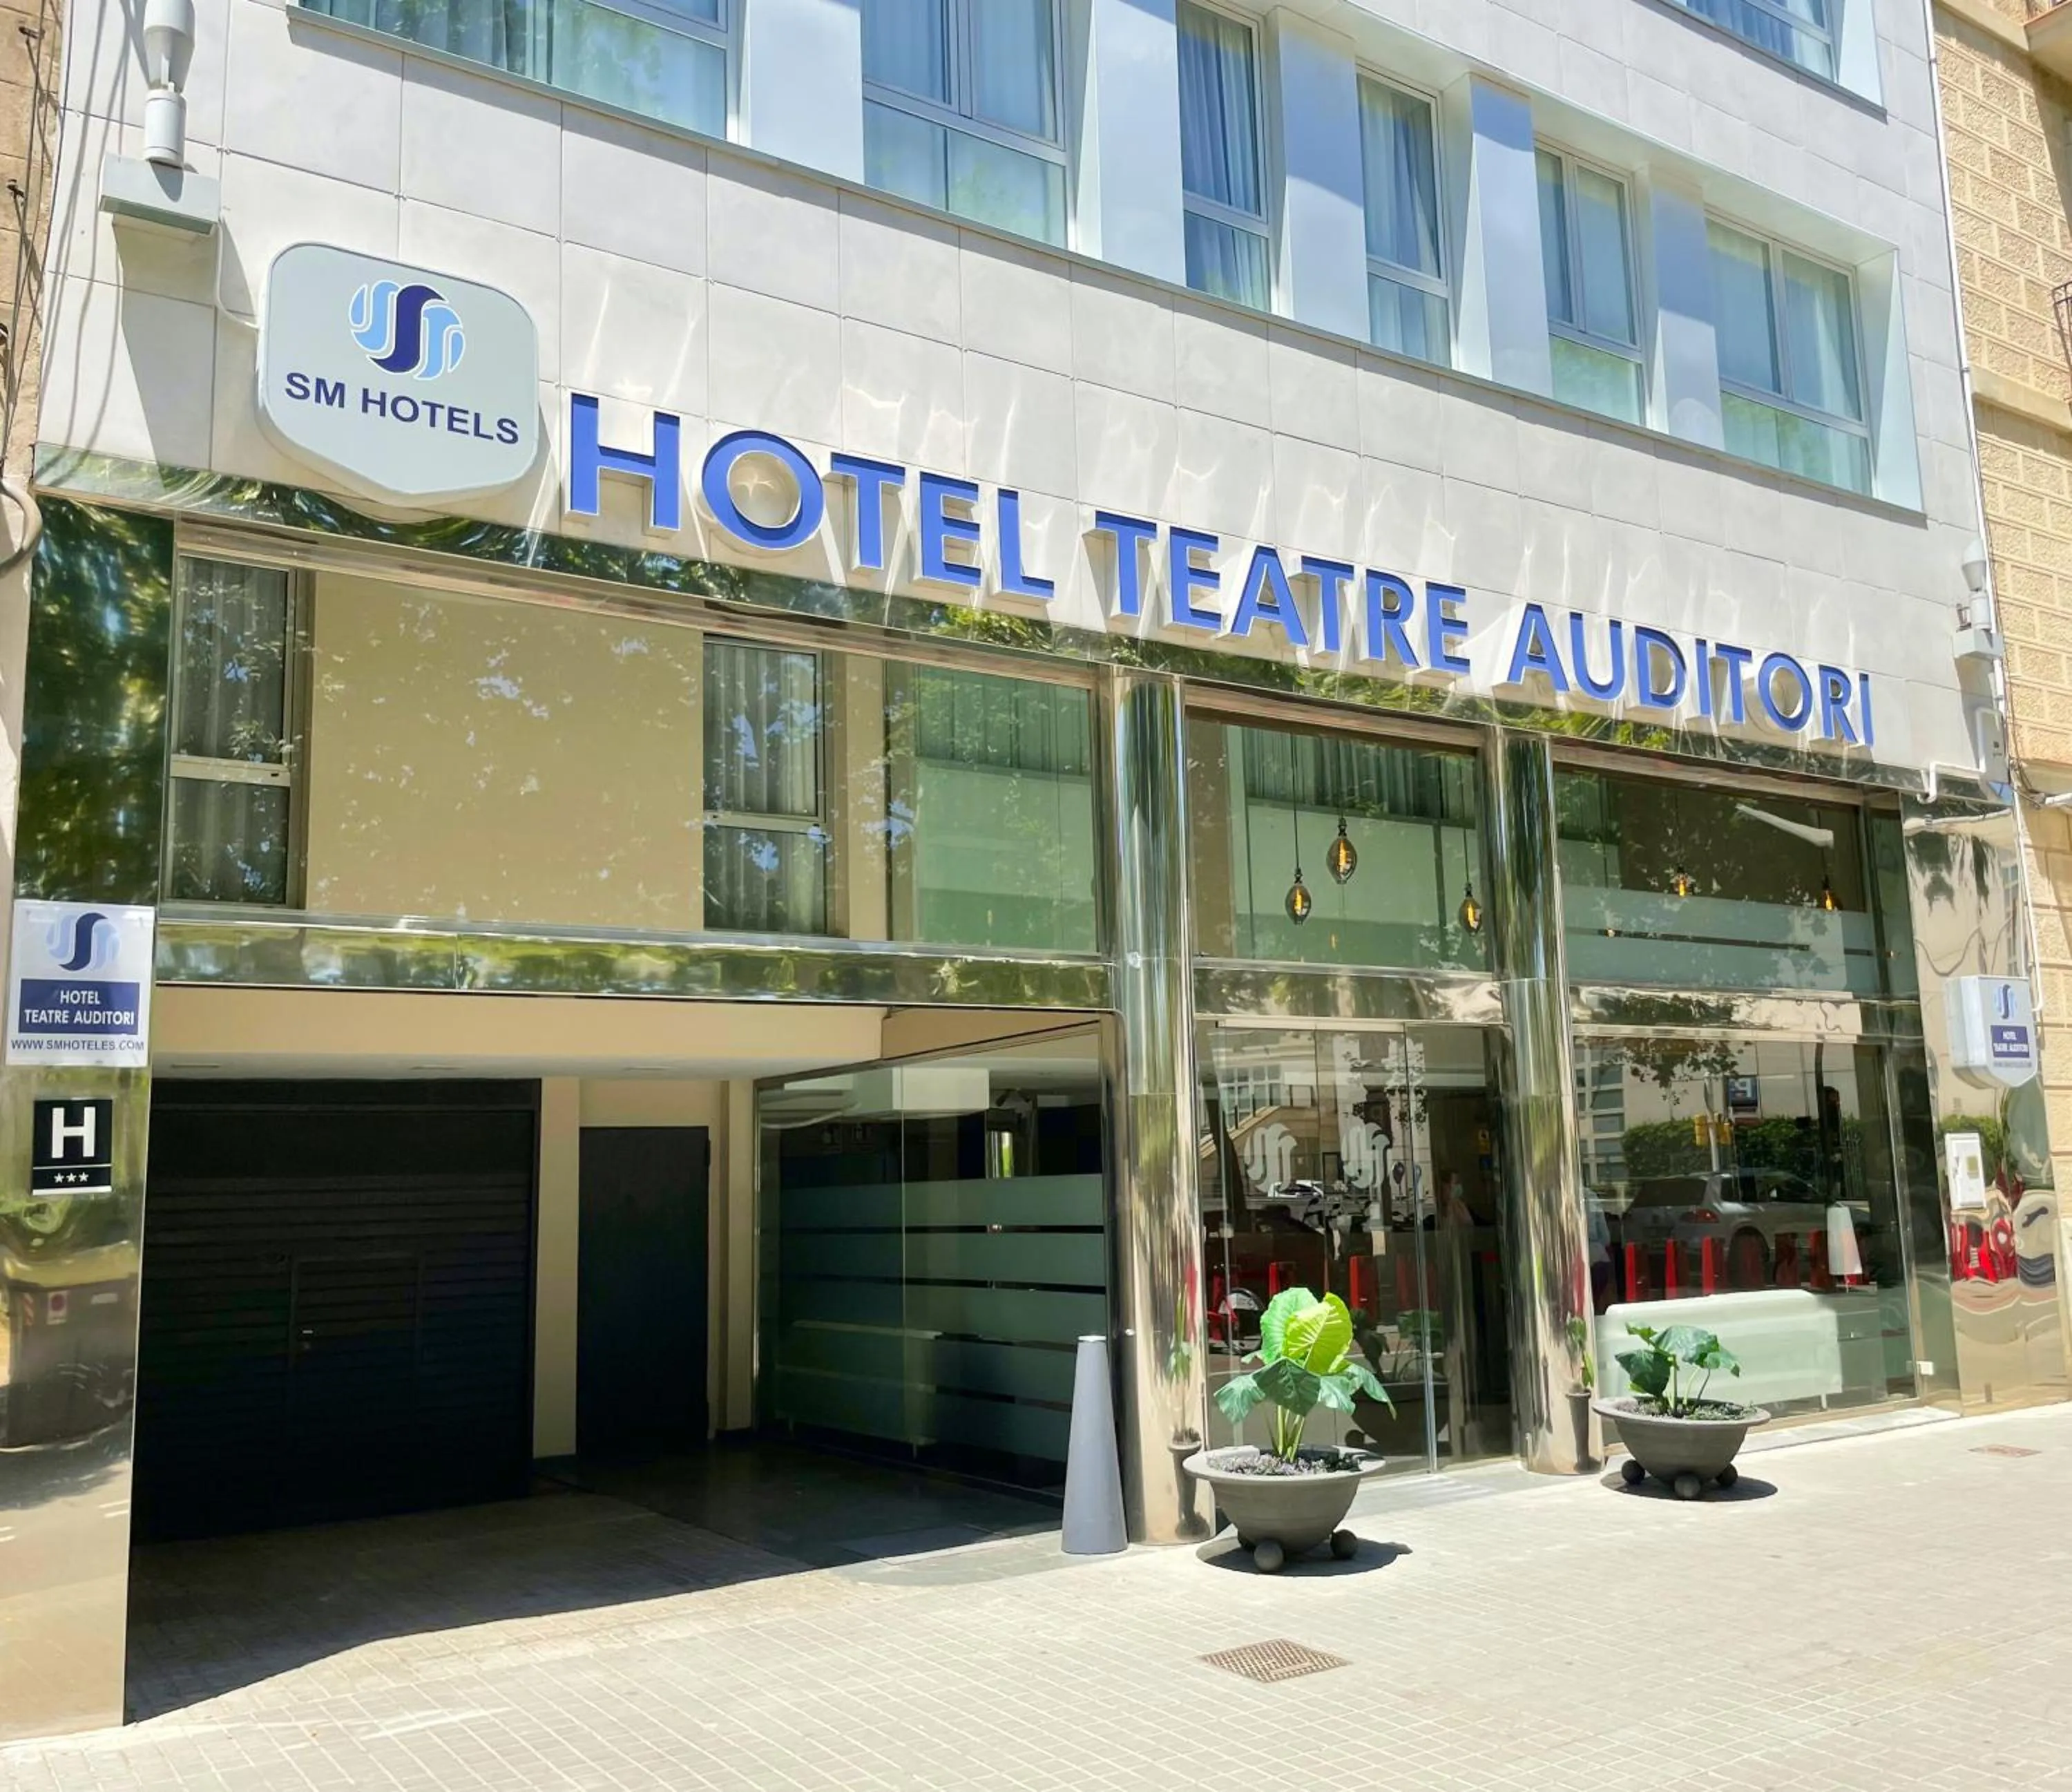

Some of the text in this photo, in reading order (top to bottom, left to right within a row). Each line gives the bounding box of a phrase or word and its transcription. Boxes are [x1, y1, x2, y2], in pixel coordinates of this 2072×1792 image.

[285, 372, 519, 444] SM HOTELS
[570, 392, 1874, 746] HOTEL TEATRE AUDITORI
[59, 990, 100, 1005] HOTEL
[24, 1009, 135, 1026] TEATRE AUDITORI
[10, 1039, 144, 1051] WWW.SMHOTELES.COM
[51, 1107, 96, 1159] H
